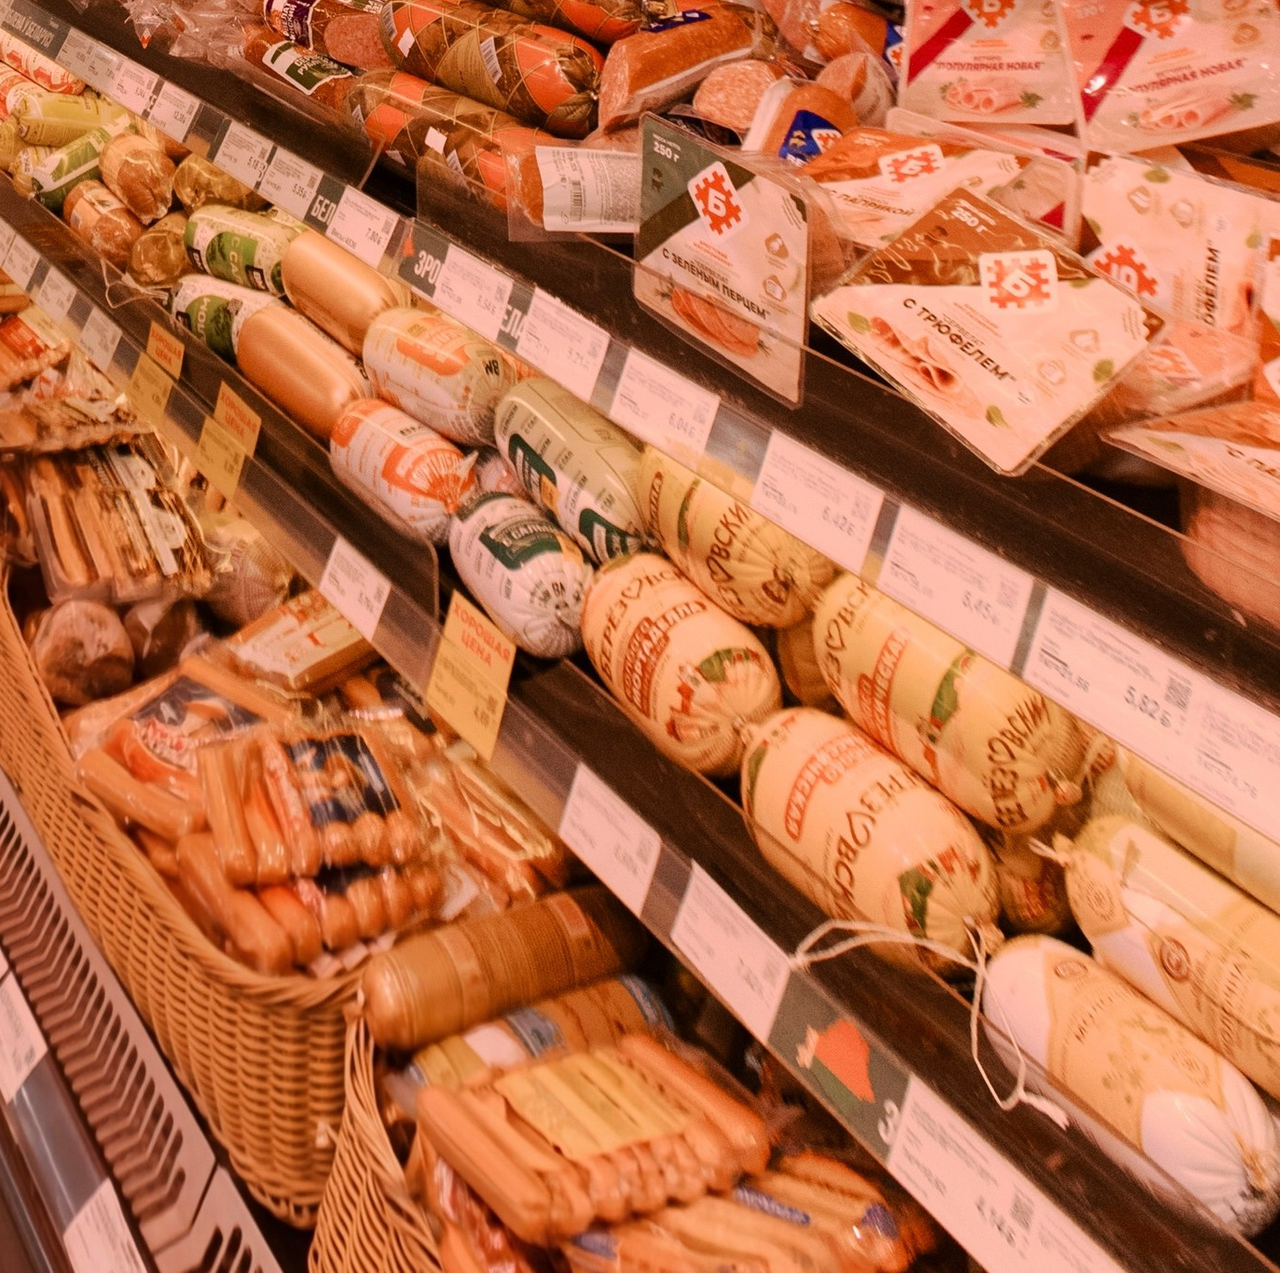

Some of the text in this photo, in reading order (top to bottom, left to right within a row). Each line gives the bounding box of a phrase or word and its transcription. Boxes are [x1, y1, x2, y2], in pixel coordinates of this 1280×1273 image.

[1150, 2, 1171, 24] Б
[653, 142, 672, 159] 250
[707, 187, 727, 217] Б
[839, 193, 916, 216] ПАПРИКОЙ
[950, 207, 980, 228] 250
[662, 247, 670, 259] С
[672, 253, 720, 292] ЗЕЛЁНЫМ
[1000, 268, 1038, 297] Б
[903, 298, 917, 309] С
[221, 392, 258, 434] ХОРОШАЯ
[453, 602, 511, 662] ХОРОШАЯ
[461, 628, 493, 668] ЦЕНА
[1124, 685, 1160, 720] 5,82
